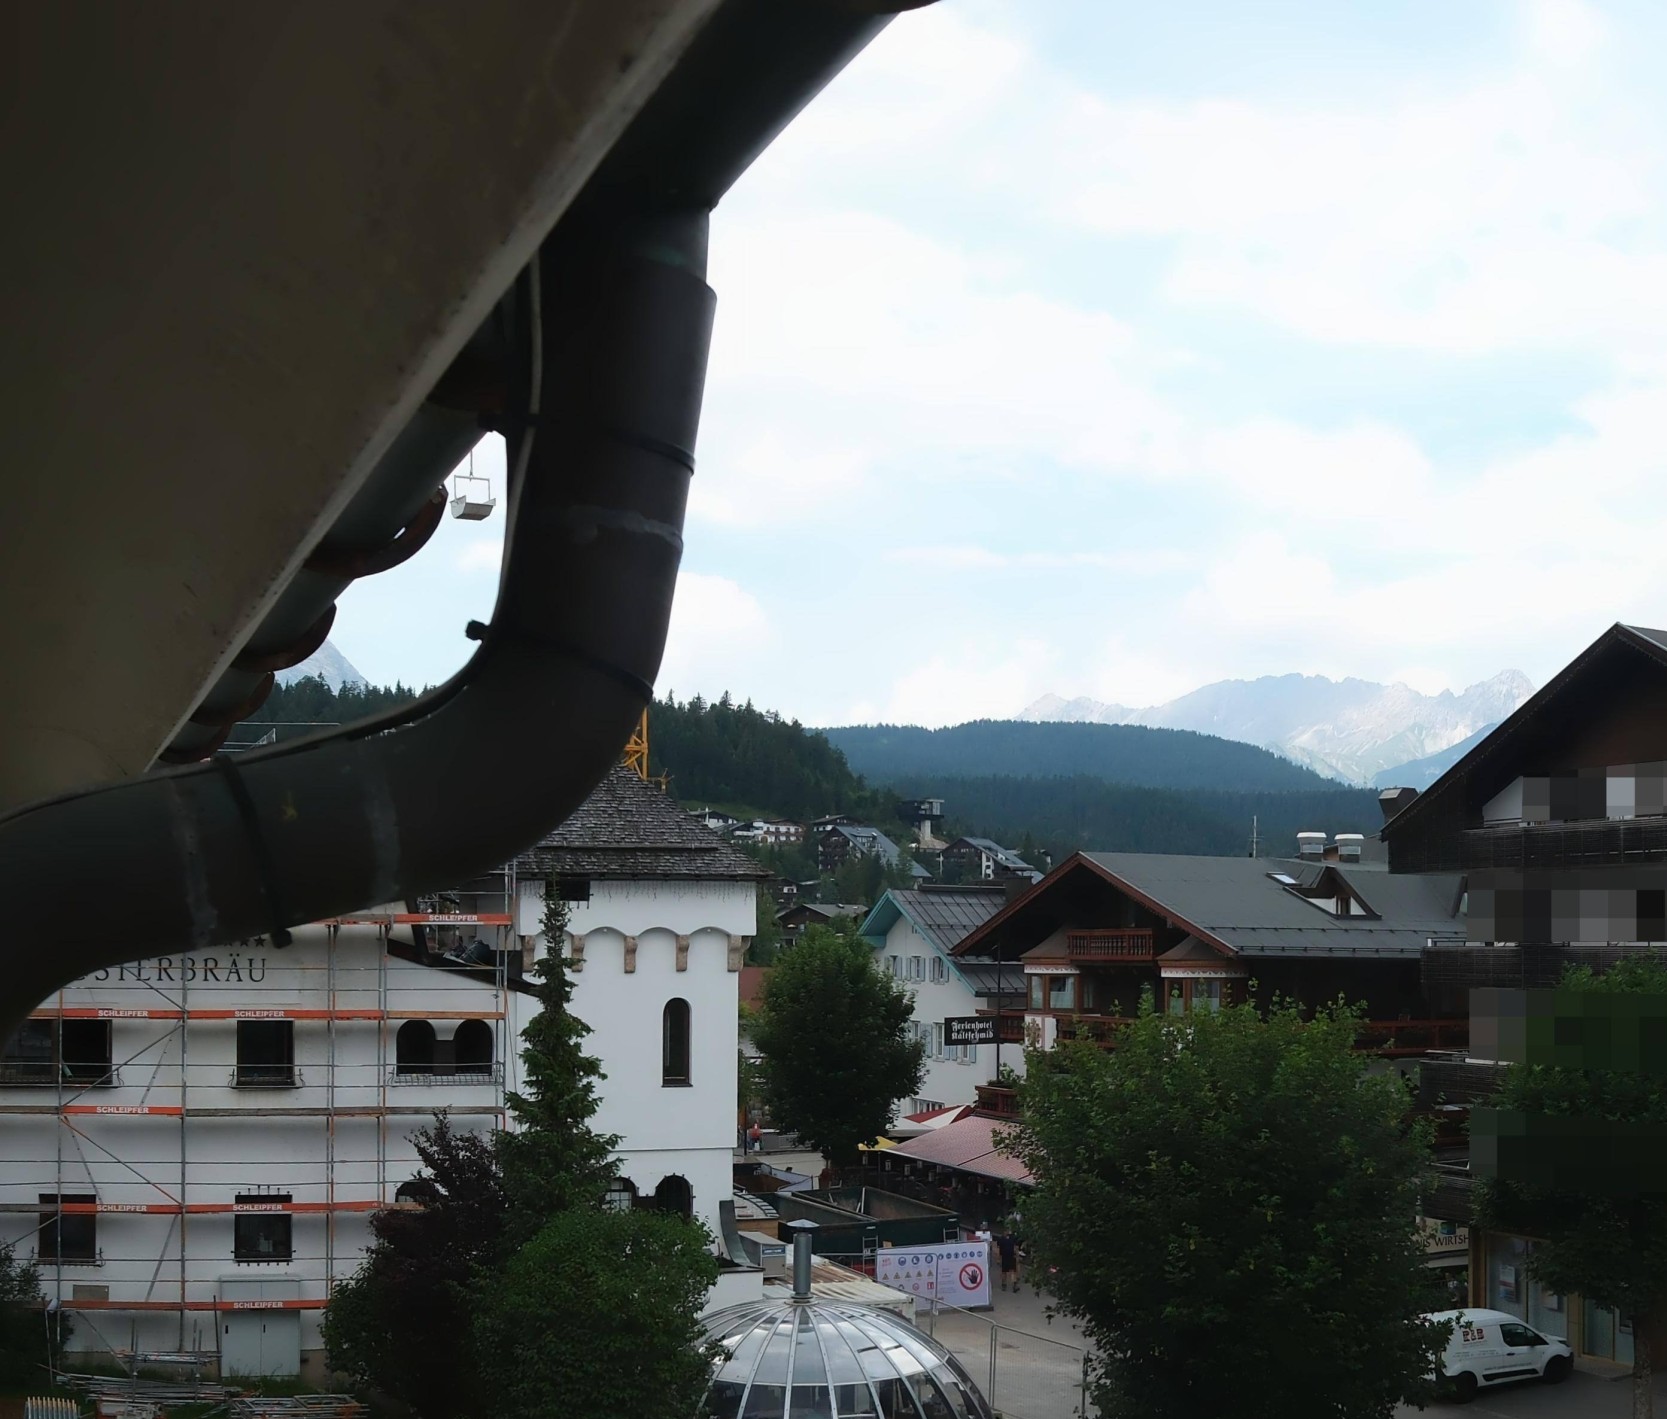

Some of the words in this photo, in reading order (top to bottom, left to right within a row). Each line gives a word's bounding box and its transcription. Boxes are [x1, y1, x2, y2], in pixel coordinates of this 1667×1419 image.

[73, 951, 267, 983] STERBRÄU
[98, 1010, 148, 1018] SCHLEIPFER
[235, 1010, 285, 1018] SCHLEIPFER
[96, 1106, 149, 1114] SCHLEIPFER
[233, 1301, 284, 1309] SCHLEIPFER
